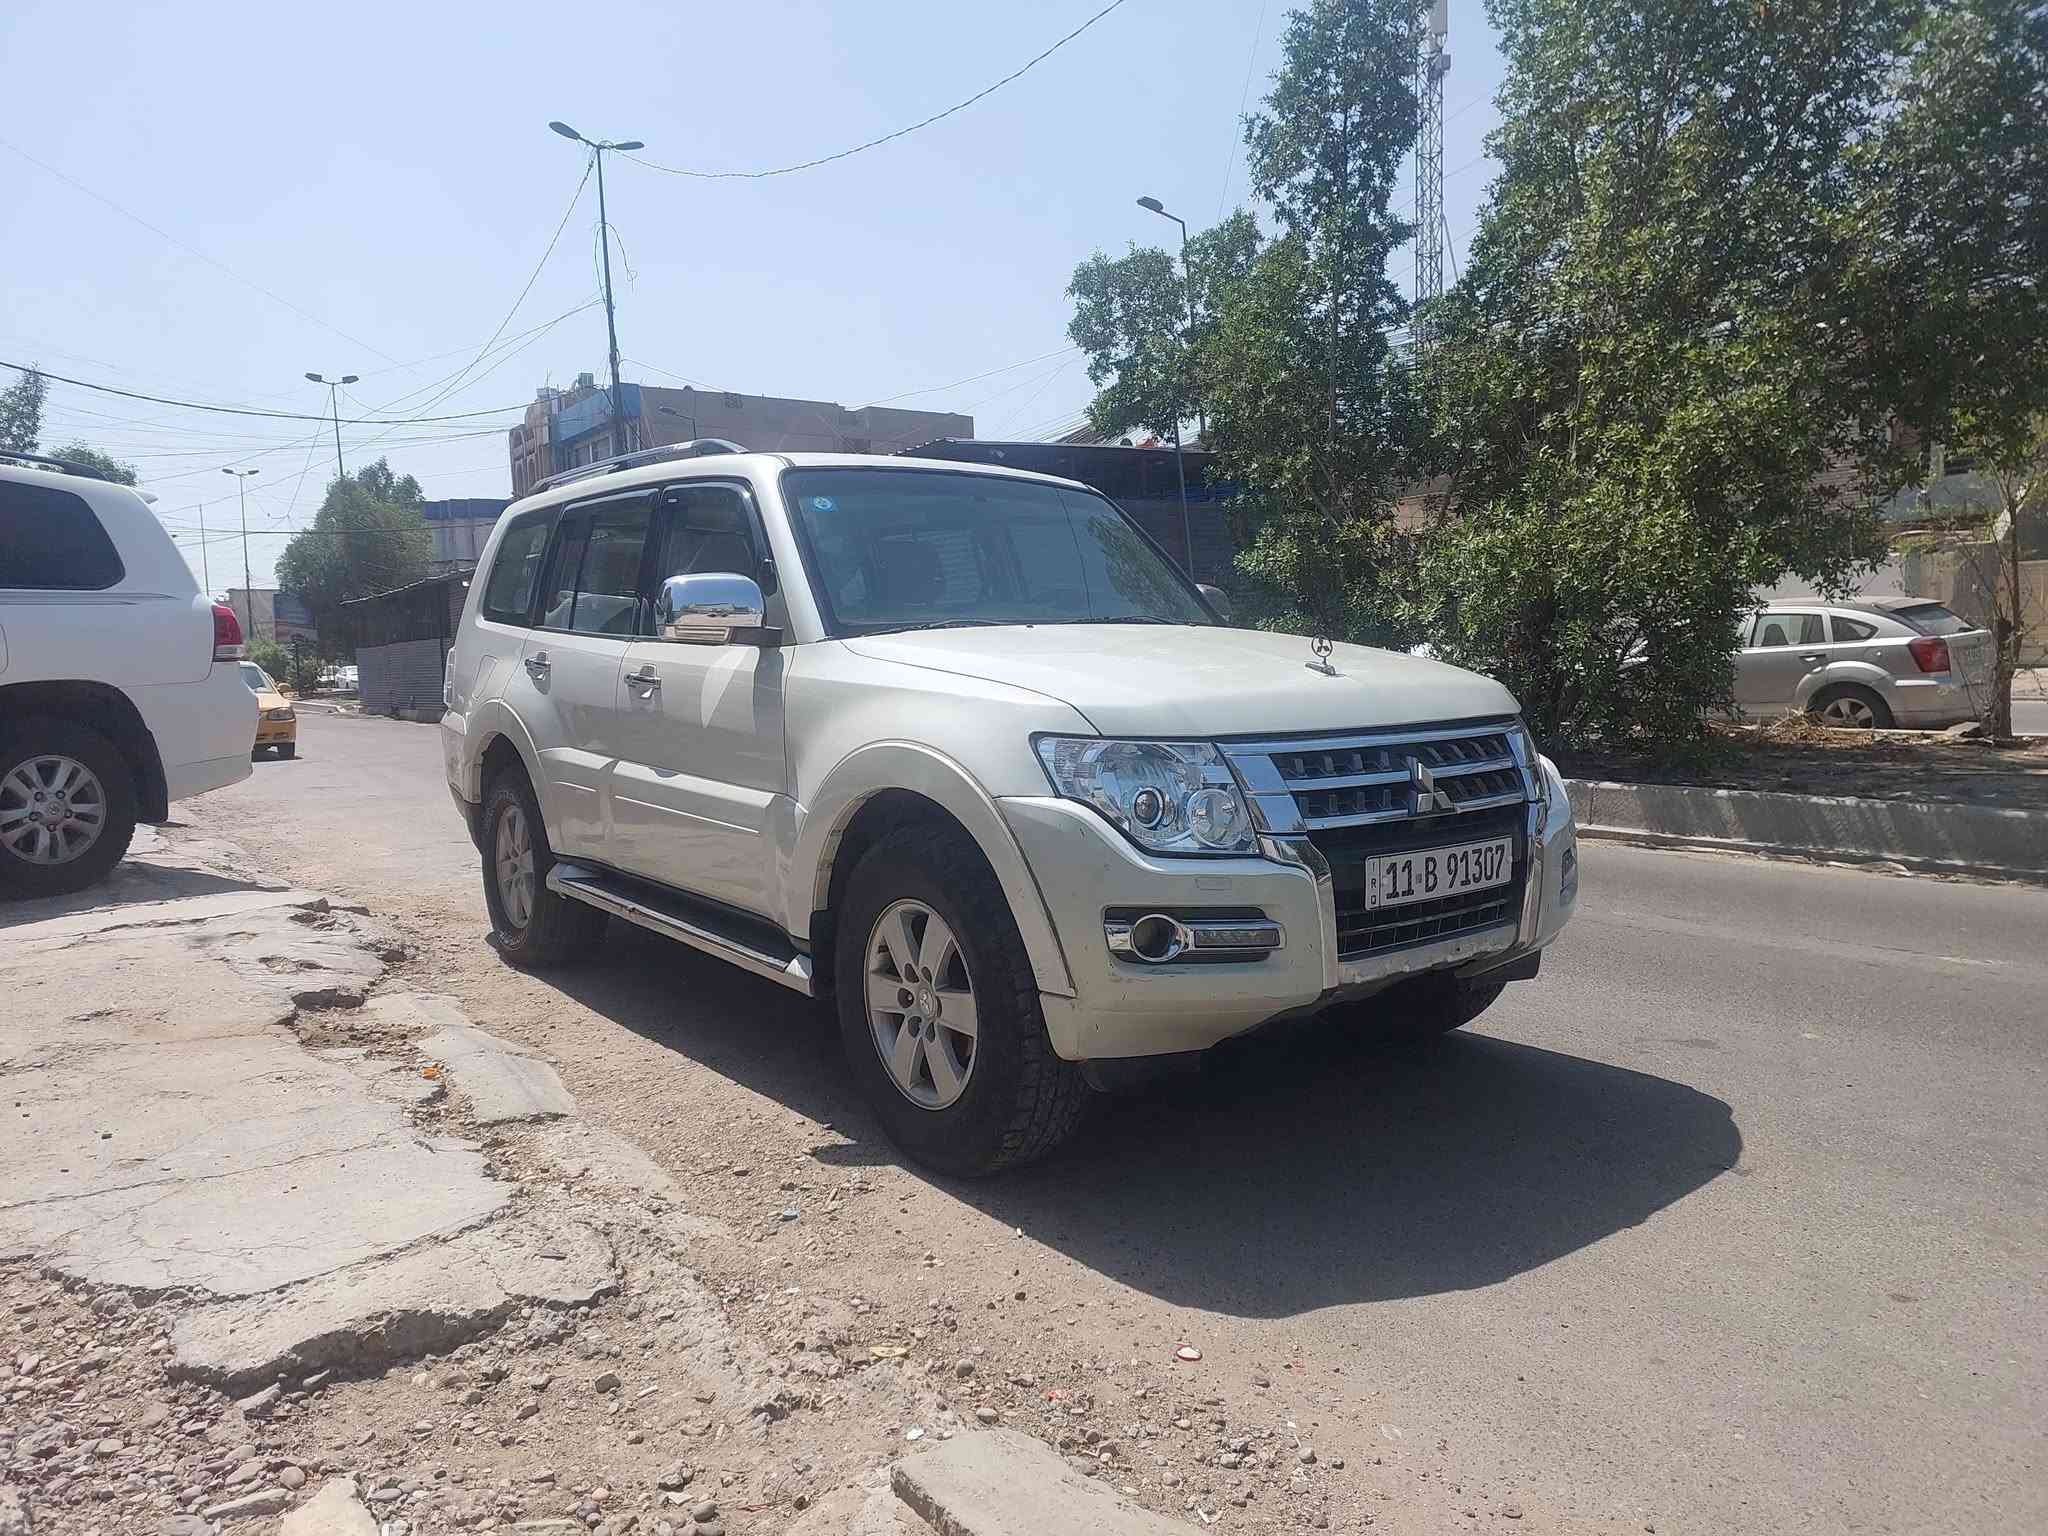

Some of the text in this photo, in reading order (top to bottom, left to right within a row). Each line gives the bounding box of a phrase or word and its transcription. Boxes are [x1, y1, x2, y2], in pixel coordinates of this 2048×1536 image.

[1386, 844, 1505, 899] 11 B 91307
